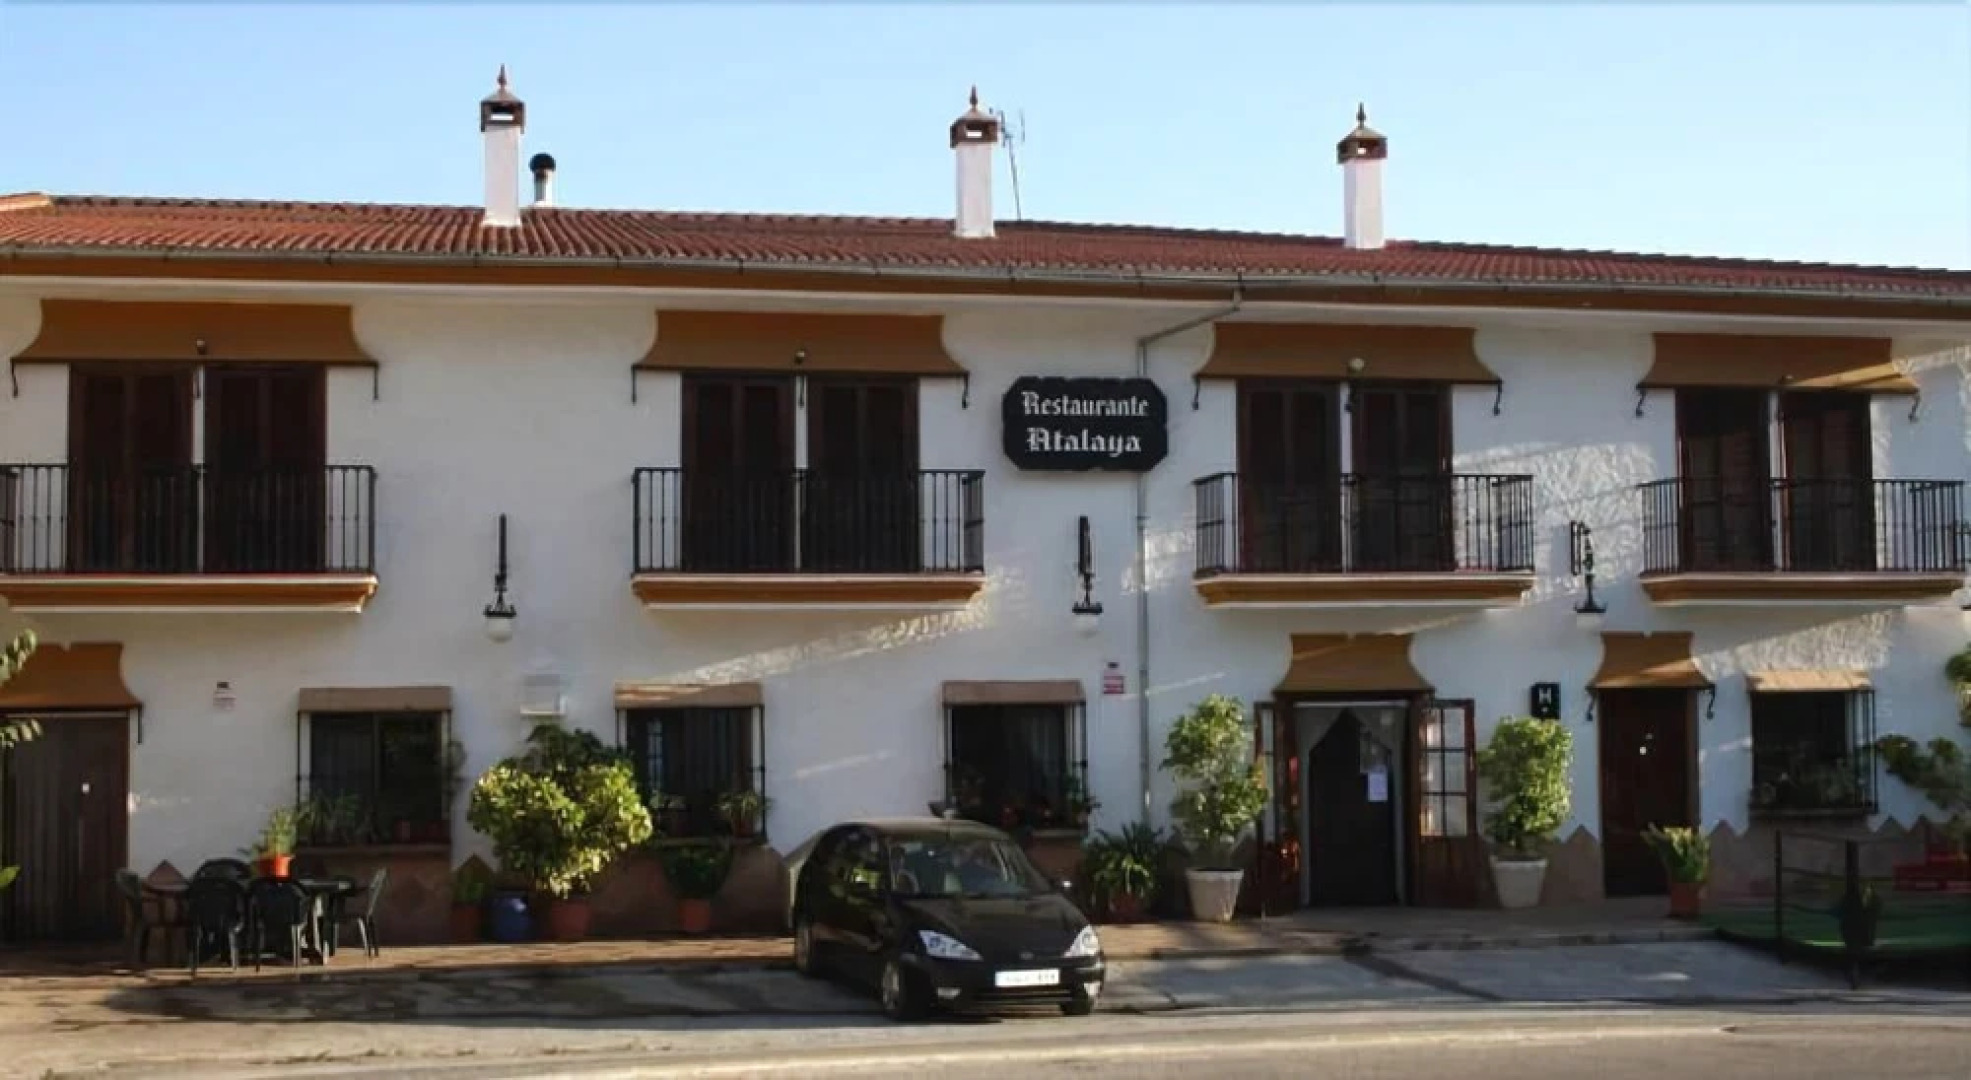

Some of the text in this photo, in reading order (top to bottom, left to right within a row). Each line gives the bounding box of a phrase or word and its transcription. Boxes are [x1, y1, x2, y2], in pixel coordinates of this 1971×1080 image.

[1020, 391, 1149, 417] Restaurante
[1026, 427, 1142, 458] Atalaya
[1538, 687, 1552, 704] H
